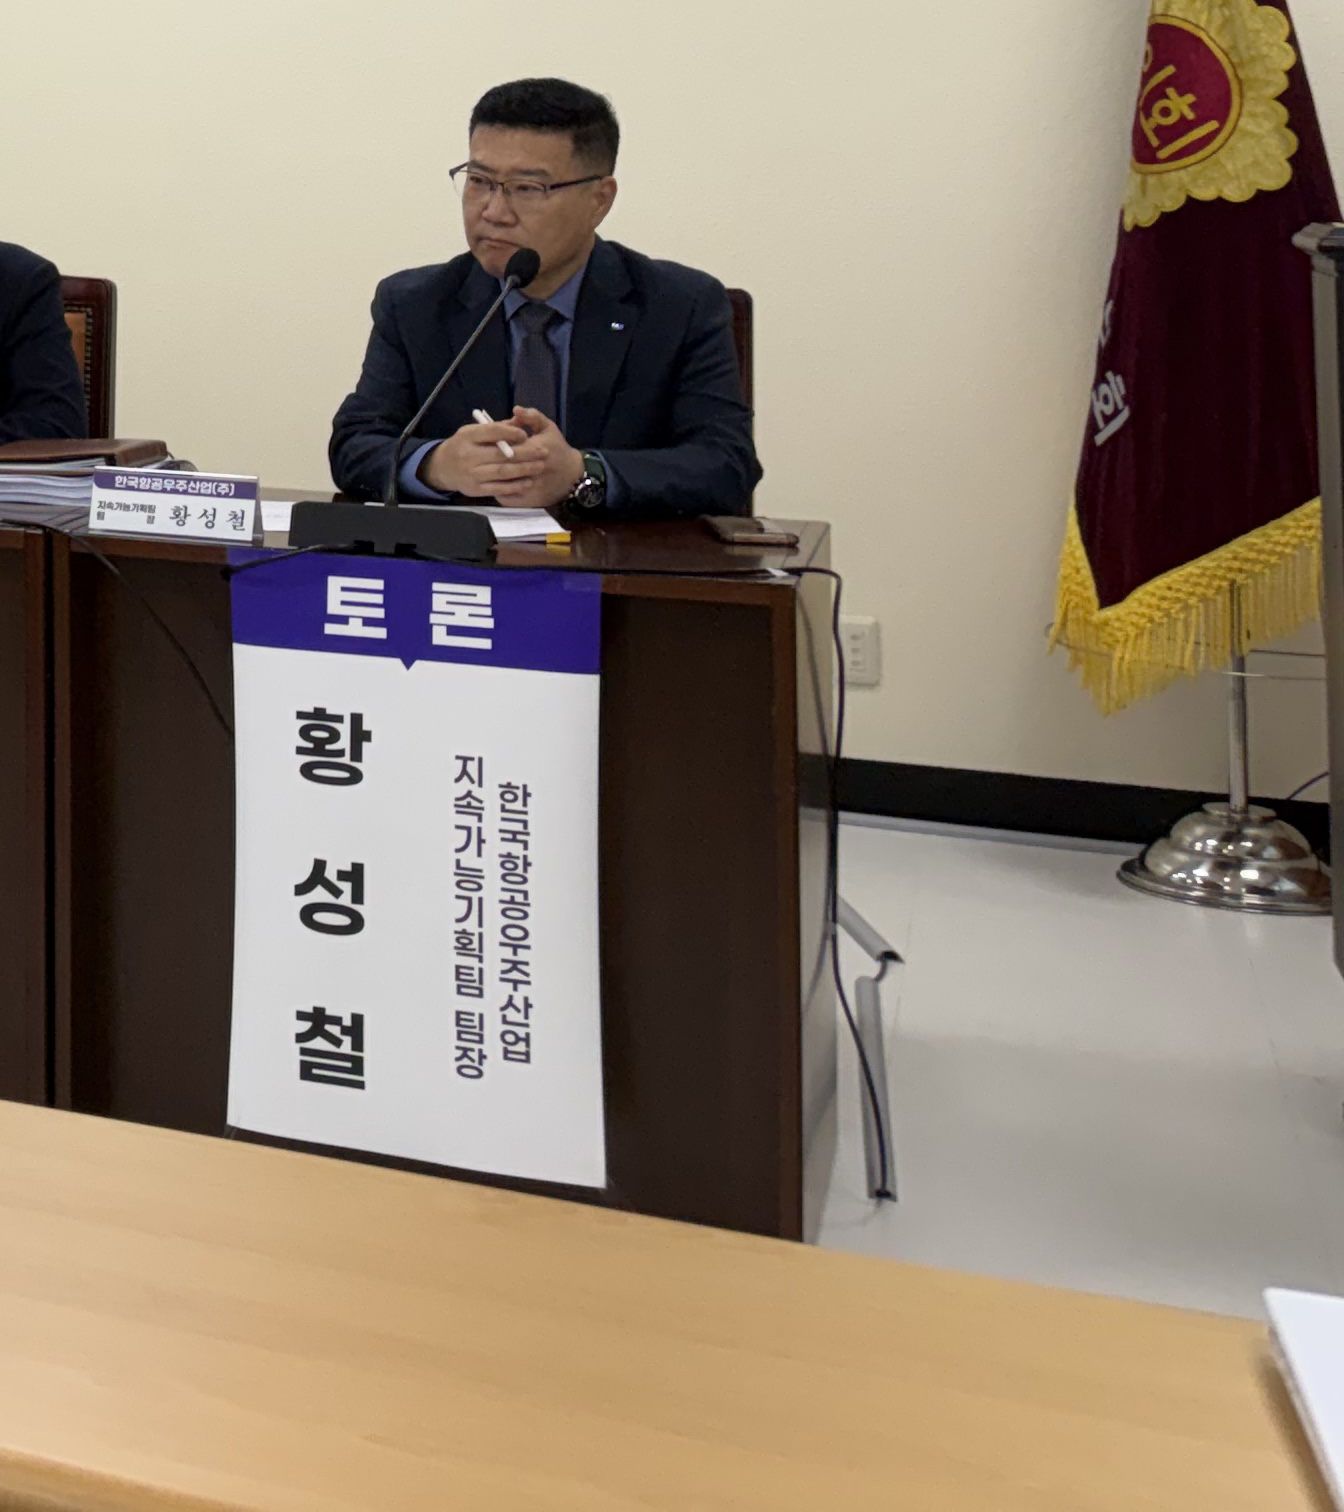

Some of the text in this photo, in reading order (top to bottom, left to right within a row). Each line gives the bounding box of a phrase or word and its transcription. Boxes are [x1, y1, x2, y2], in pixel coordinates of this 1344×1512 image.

[114, 475, 235, 496] 한국항공우주산업(주)
[453, 754, 486, 1081] 지속가능기획팀 팀장
[498, 782, 532, 1066] 한국항공우주산업
